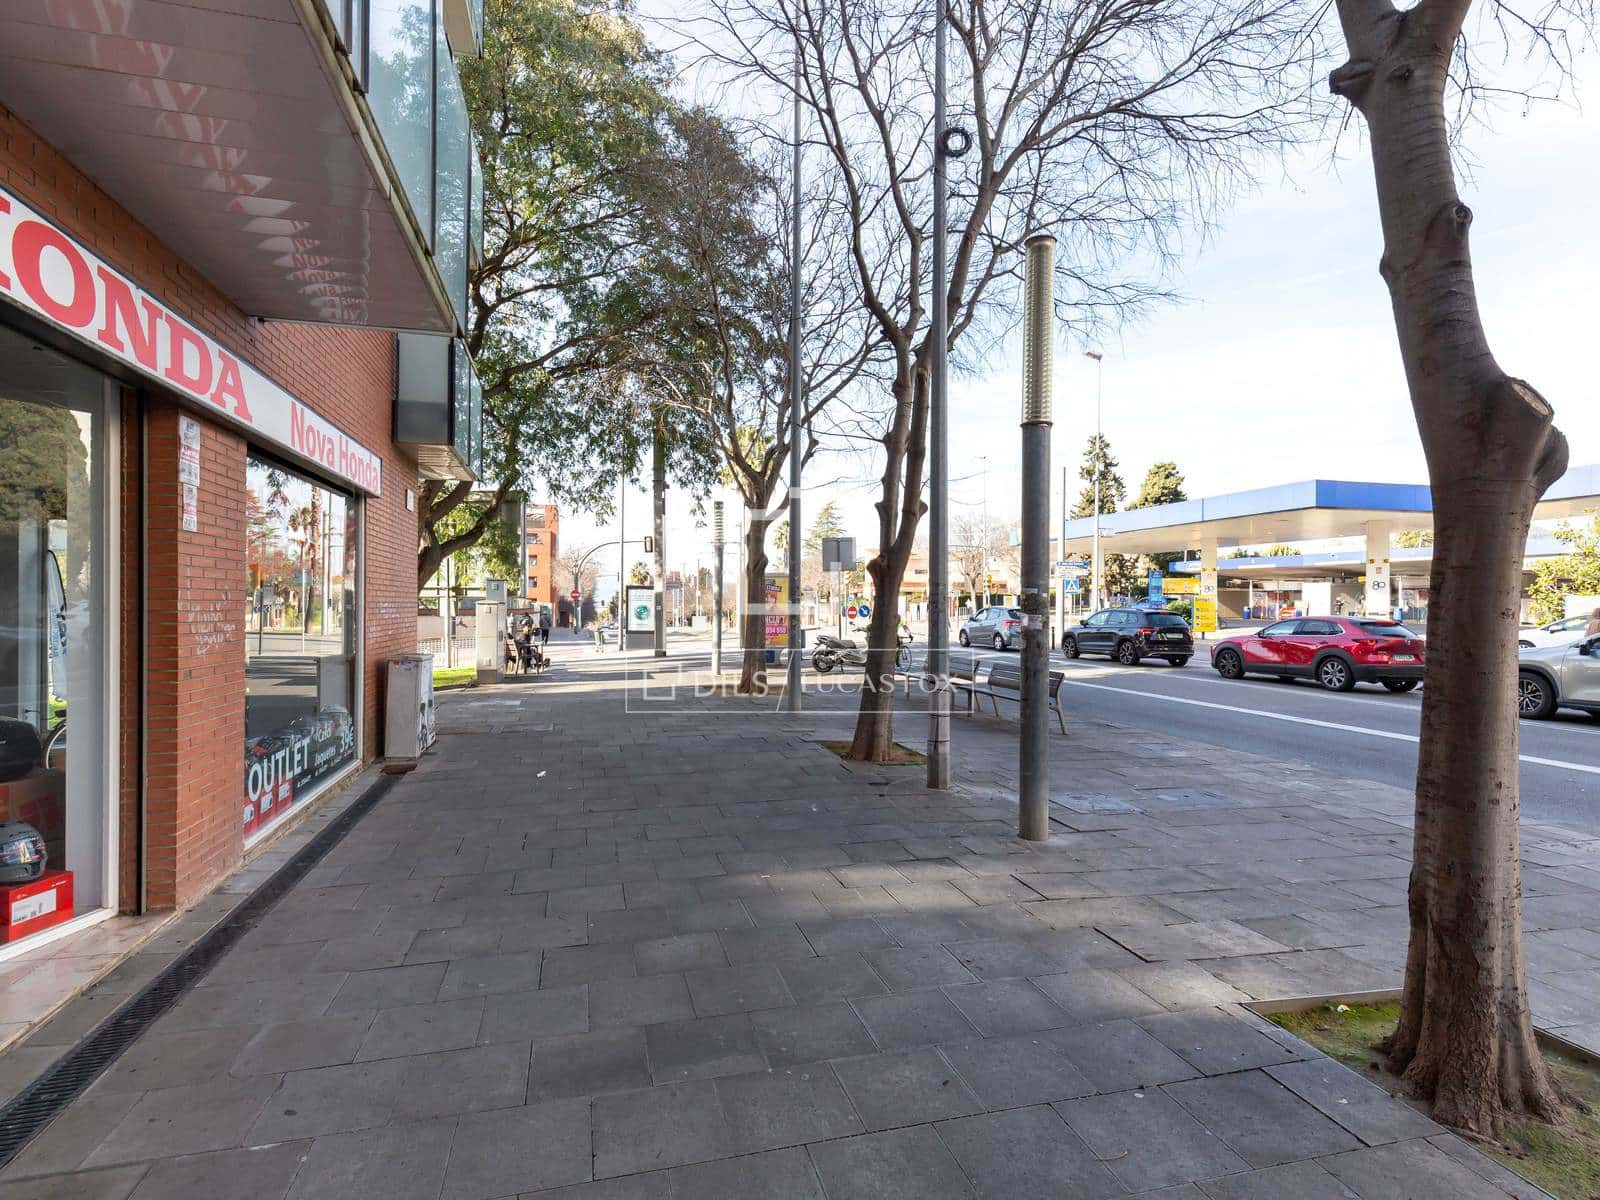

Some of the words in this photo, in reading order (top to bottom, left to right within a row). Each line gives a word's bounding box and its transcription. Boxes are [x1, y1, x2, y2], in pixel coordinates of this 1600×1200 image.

[290, 404, 335, 469] Nova
[339, 436, 379, 489] Honda
[248, 737, 310, 802] OUTLET
